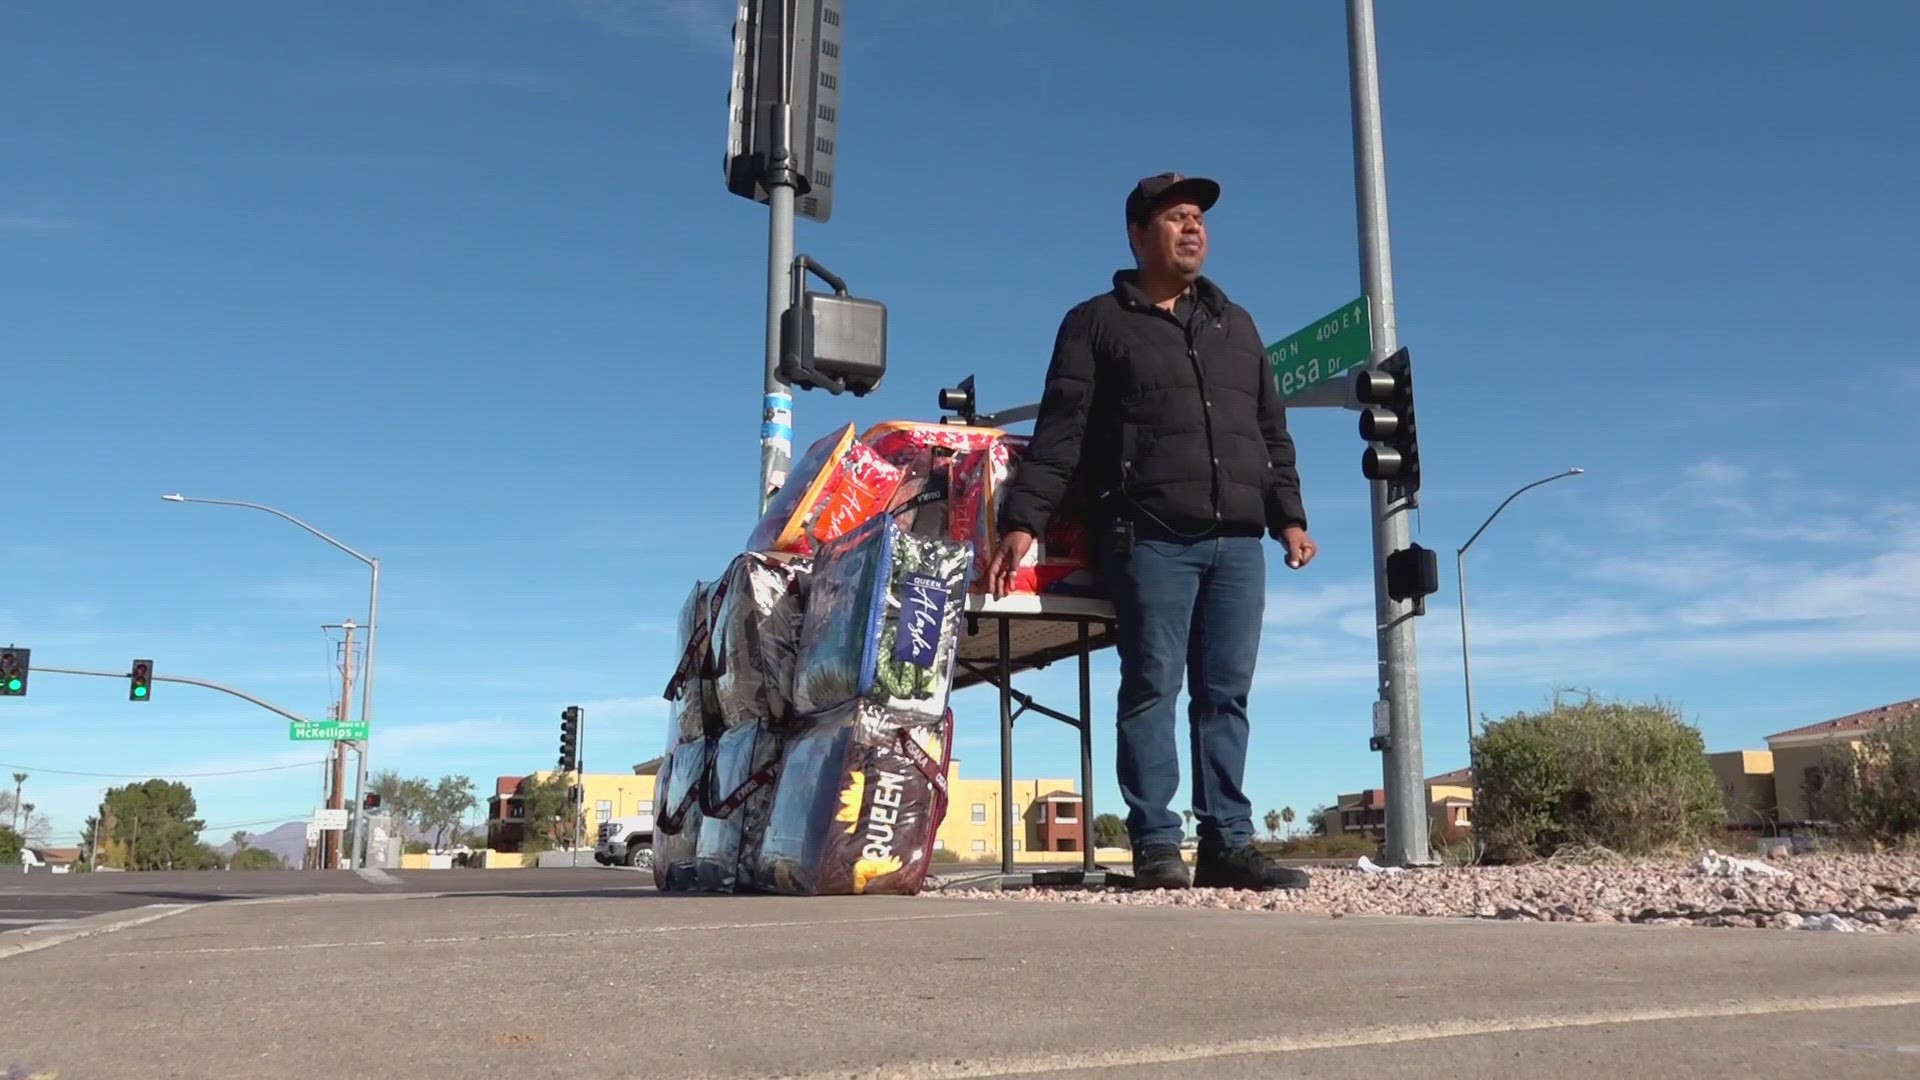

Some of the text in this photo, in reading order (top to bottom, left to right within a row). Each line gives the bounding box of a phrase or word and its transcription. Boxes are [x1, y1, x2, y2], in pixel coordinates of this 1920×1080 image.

[1267, 313, 1349, 365] 00 N 400 E
[1328, 357, 1342, 374] Dr
[914, 577, 942, 588] QUEEN
[296, 728, 352, 740] McKellips
[905, 740, 929, 768] OSAKA
[862, 770, 906, 862] QUEEN
